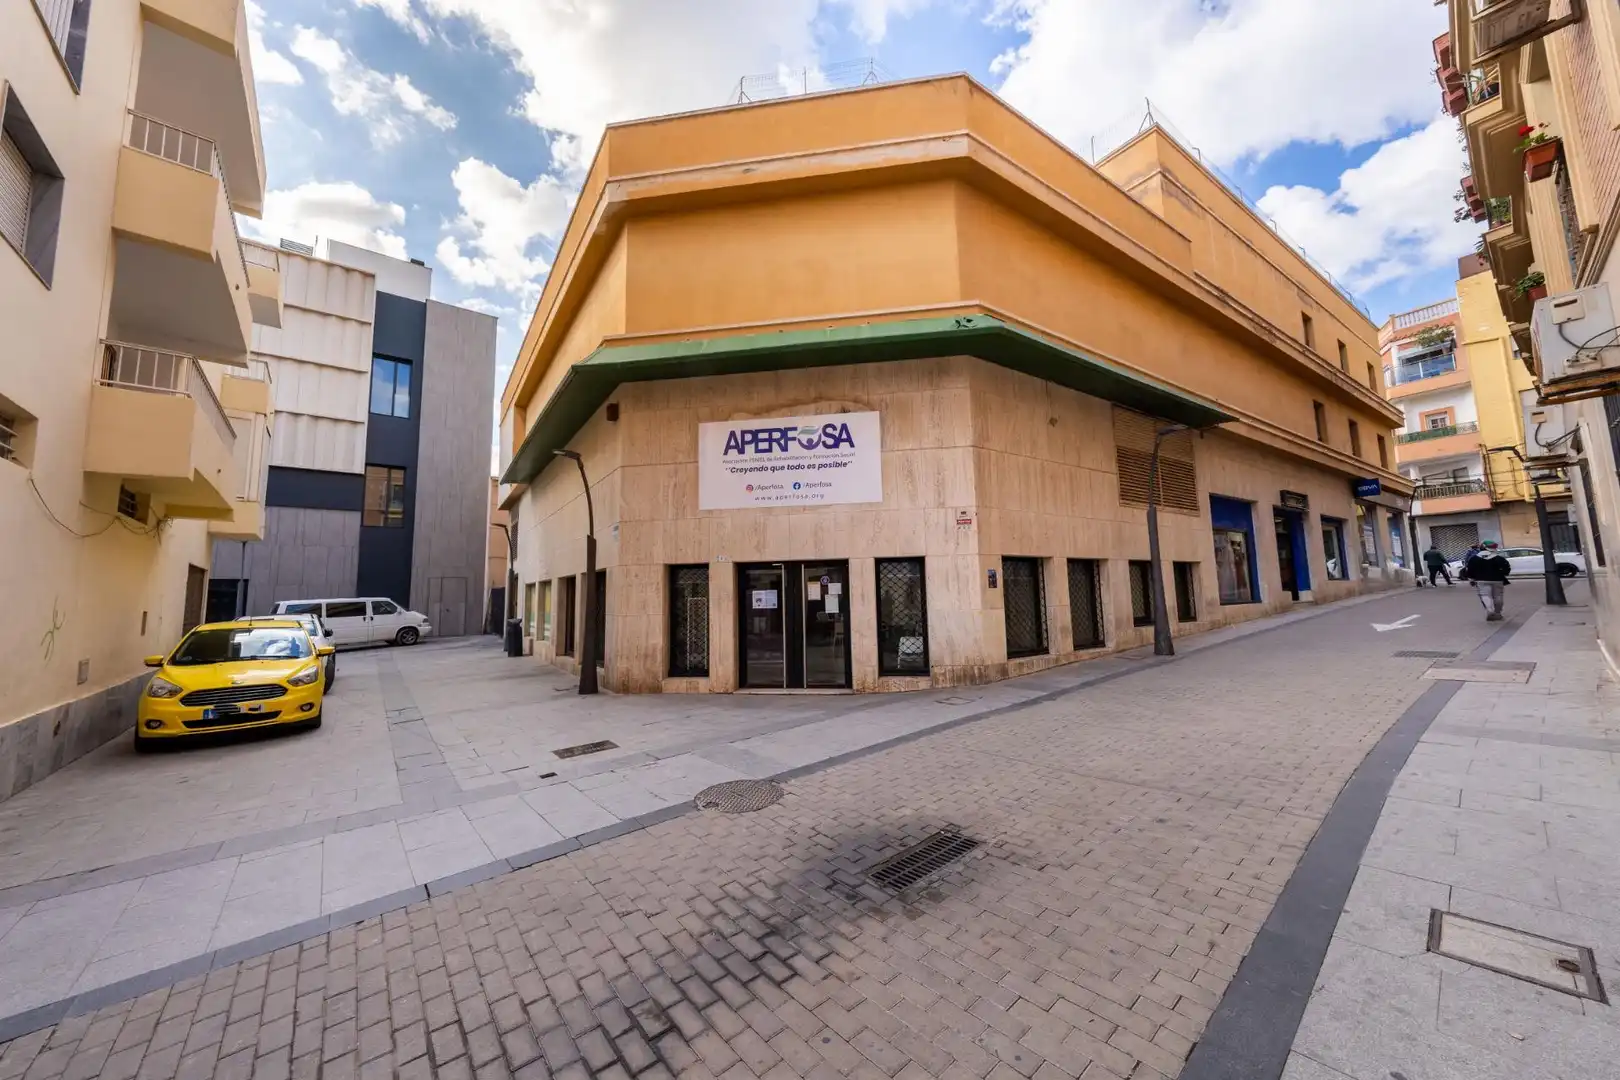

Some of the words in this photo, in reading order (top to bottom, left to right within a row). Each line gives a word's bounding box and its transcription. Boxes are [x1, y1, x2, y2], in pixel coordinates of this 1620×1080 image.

[723, 423, 855, 456] APERFOSA
[770, 465, 785, 473] que
[786, 463, 806, 471] todo
